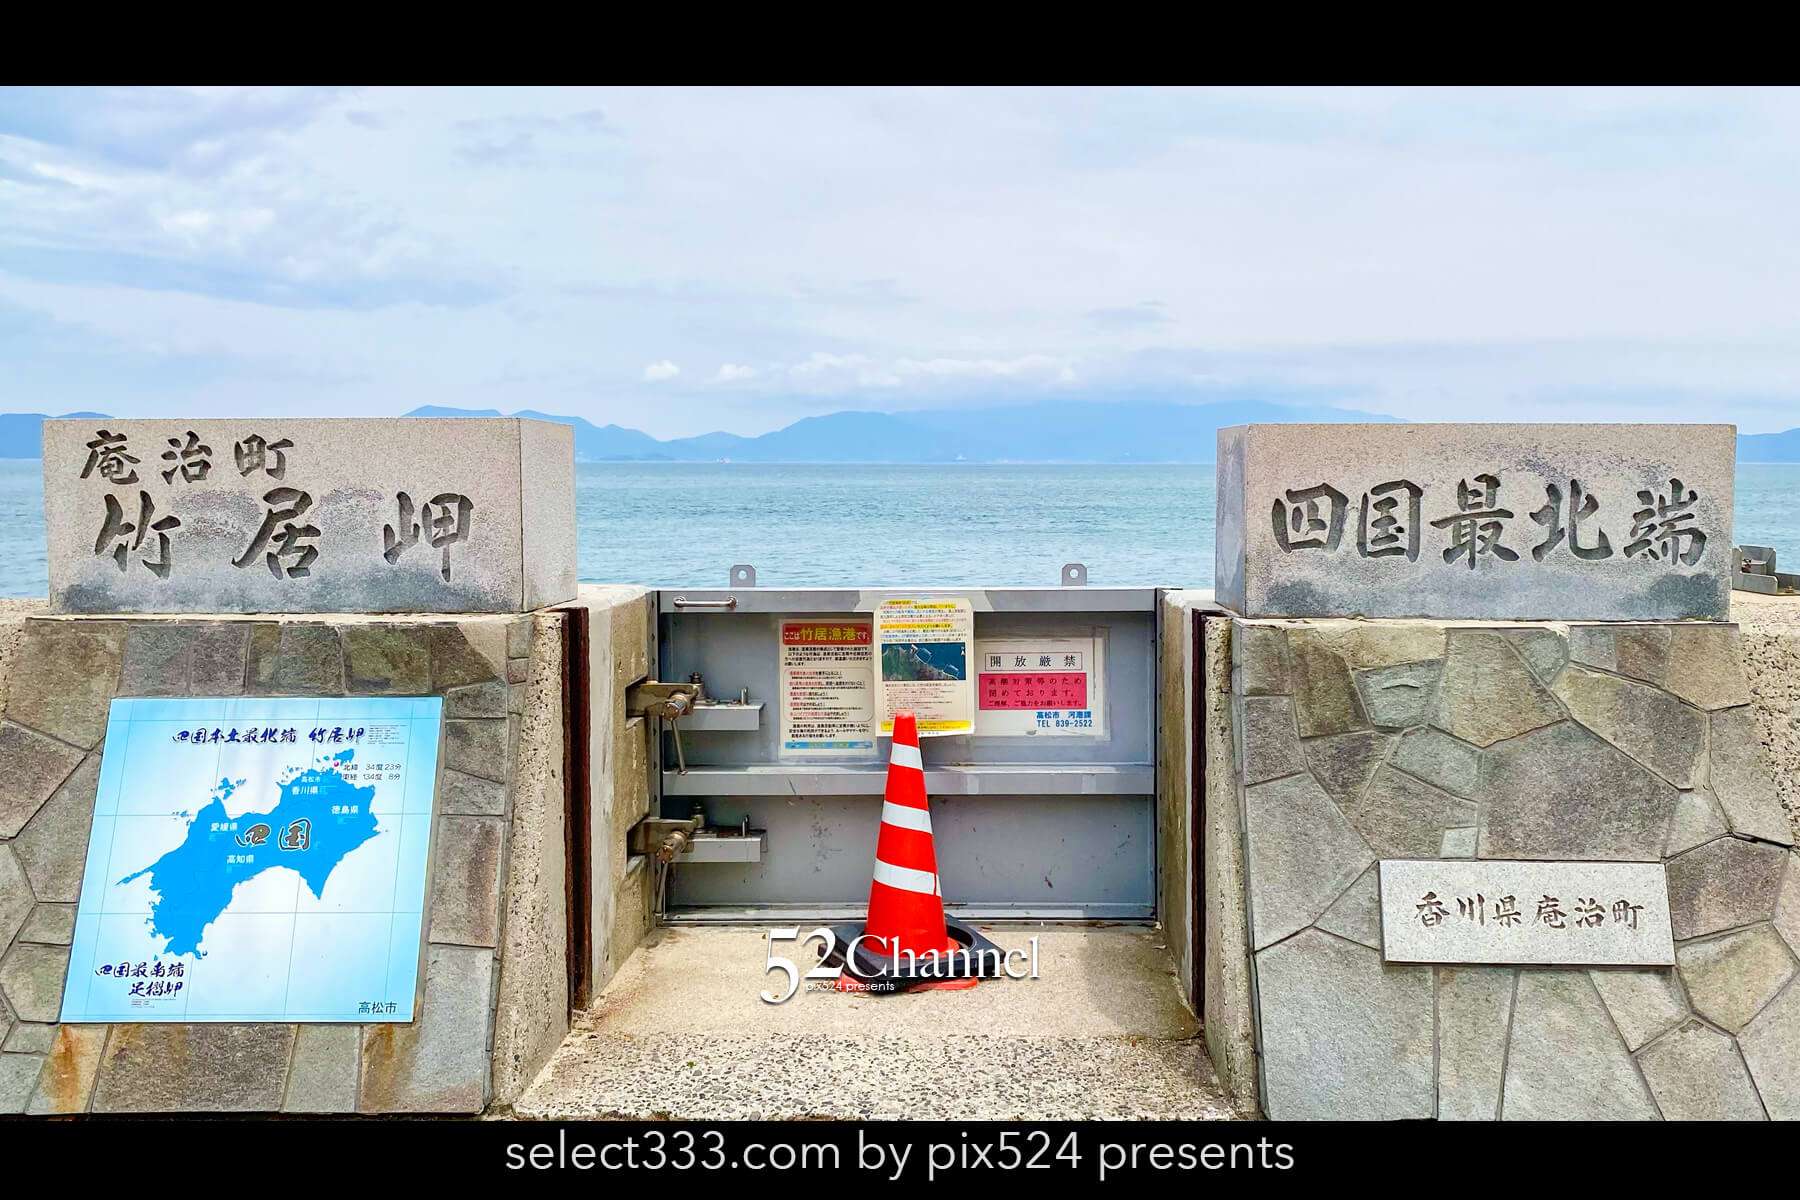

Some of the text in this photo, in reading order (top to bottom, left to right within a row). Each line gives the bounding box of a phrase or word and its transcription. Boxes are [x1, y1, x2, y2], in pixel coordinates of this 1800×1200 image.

[80, 429, 295, 485] 庵治町
[1271, 473, 1708, 570] 四国最北端
[95, 487, 475, 582] 竹居岬
[990, 655, 1076, 667] 開放厳禁
[1037, 720, 1093, 728] TEL 839-2522
[309, 727, 365, 744] 竹居岬
[292, 786, 319, 795] 香川県
[331, 805, 359, 815] 徳島県
[236, 818, 312, 851] 四国
[226, 854, 254, 864] 高知県
[358, 1001, 398, 1015] 高松市
